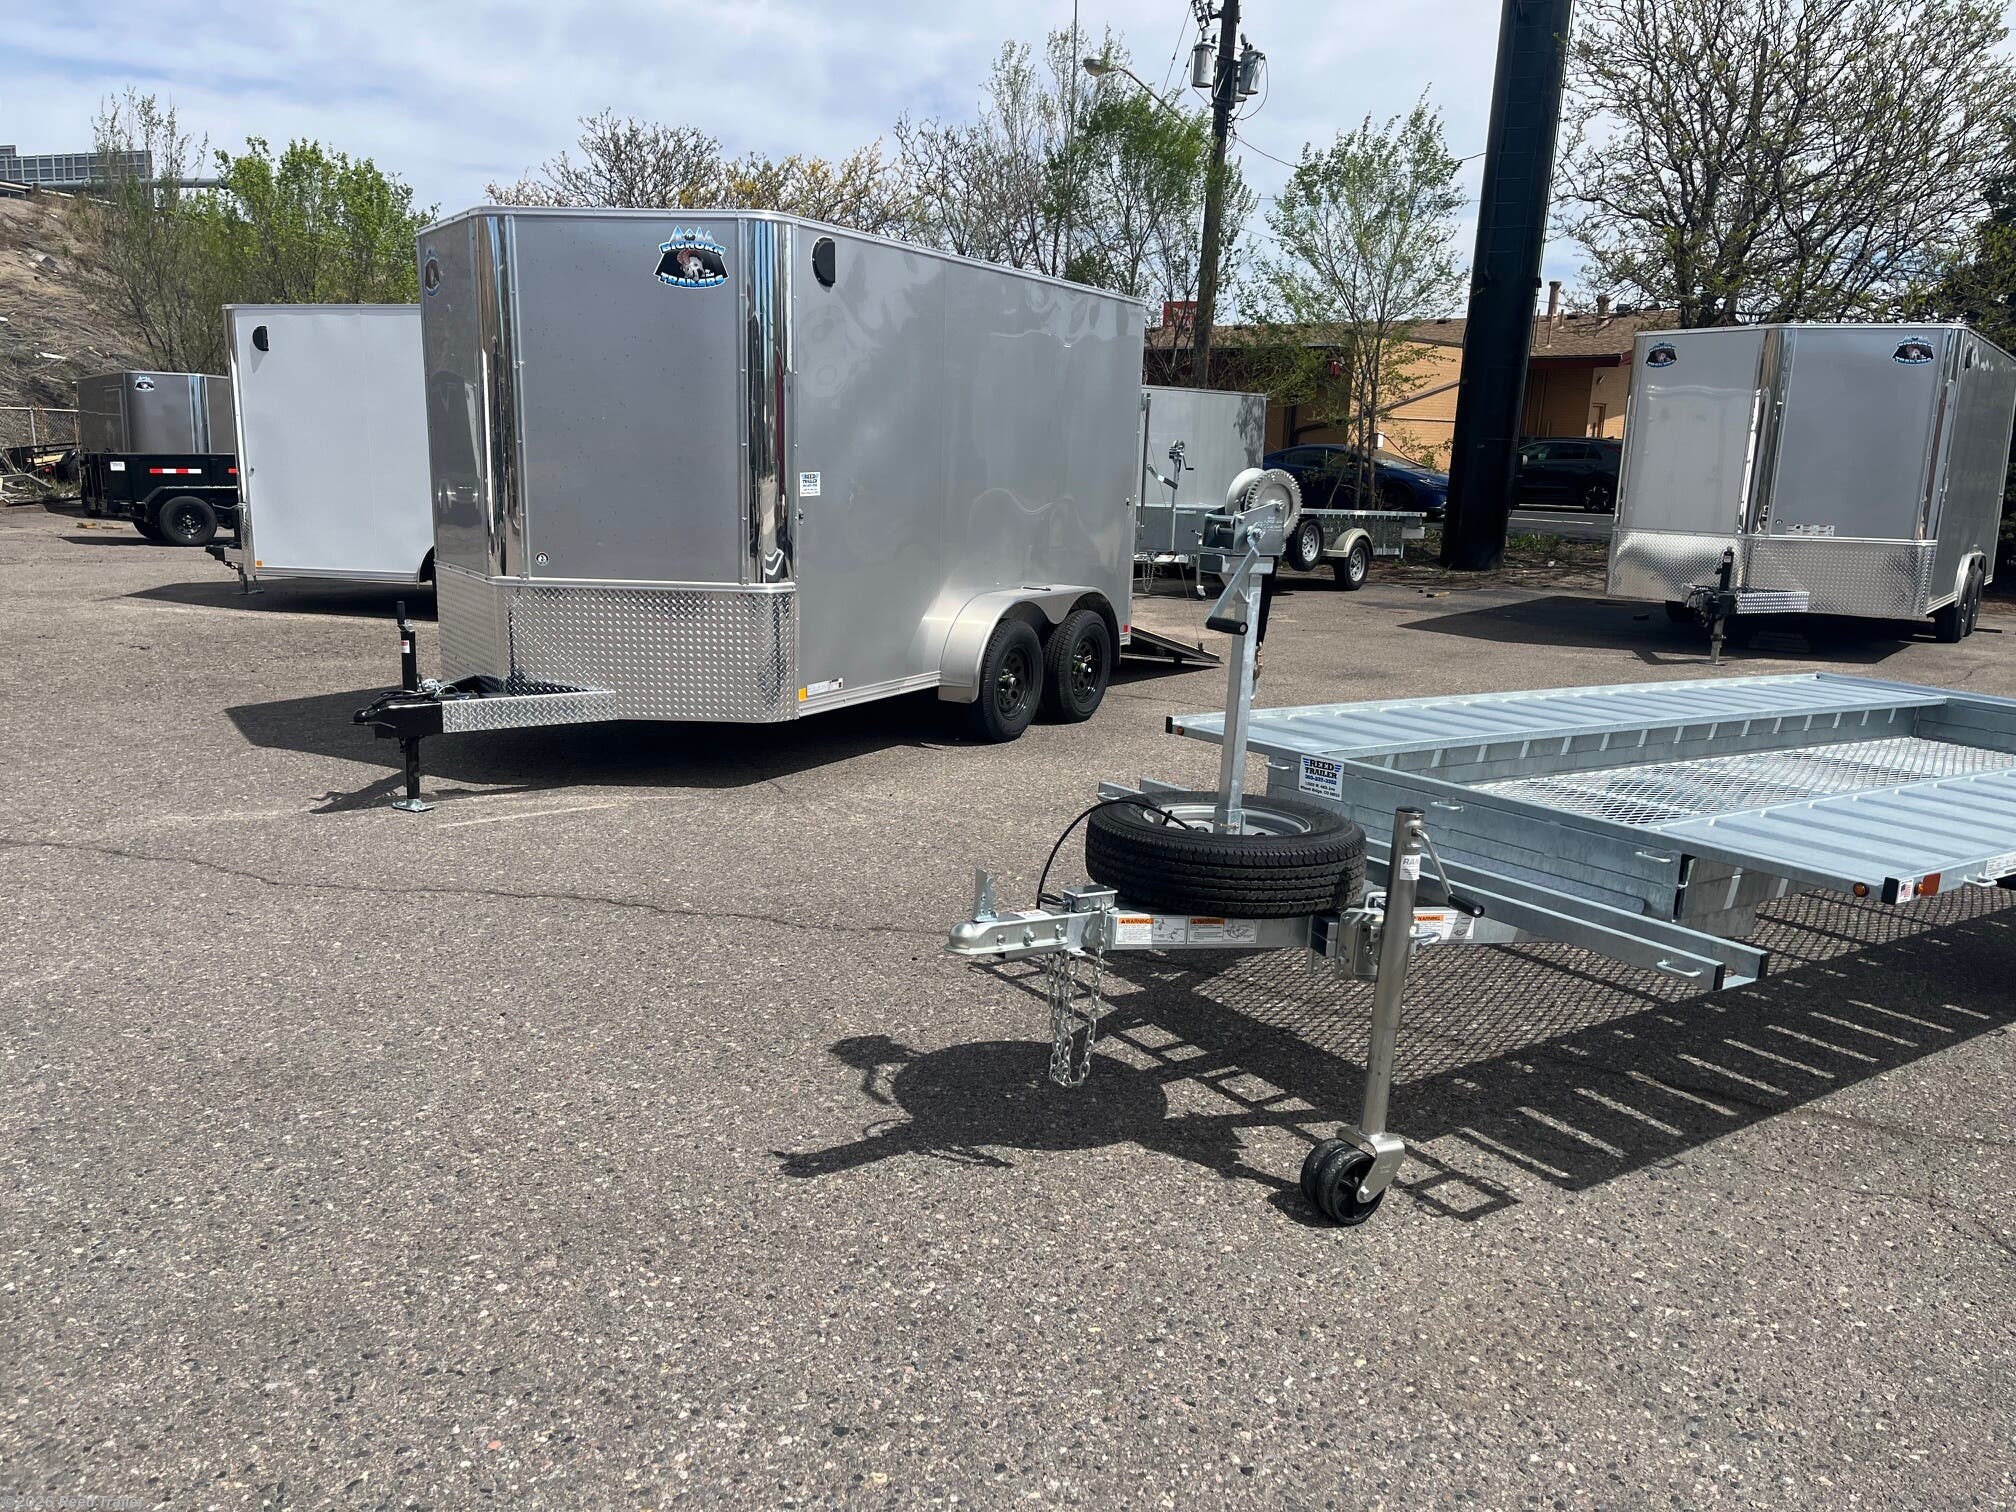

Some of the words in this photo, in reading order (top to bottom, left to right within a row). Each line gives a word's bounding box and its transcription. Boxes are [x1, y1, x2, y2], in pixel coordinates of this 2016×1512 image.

[660, 241, 726, 256] BIGHORN
[660, 272, 725, 288] TRAILERS
[1309, 760, 1334, 771] REED
[1305, 767, 1337, 779] TRAILER
